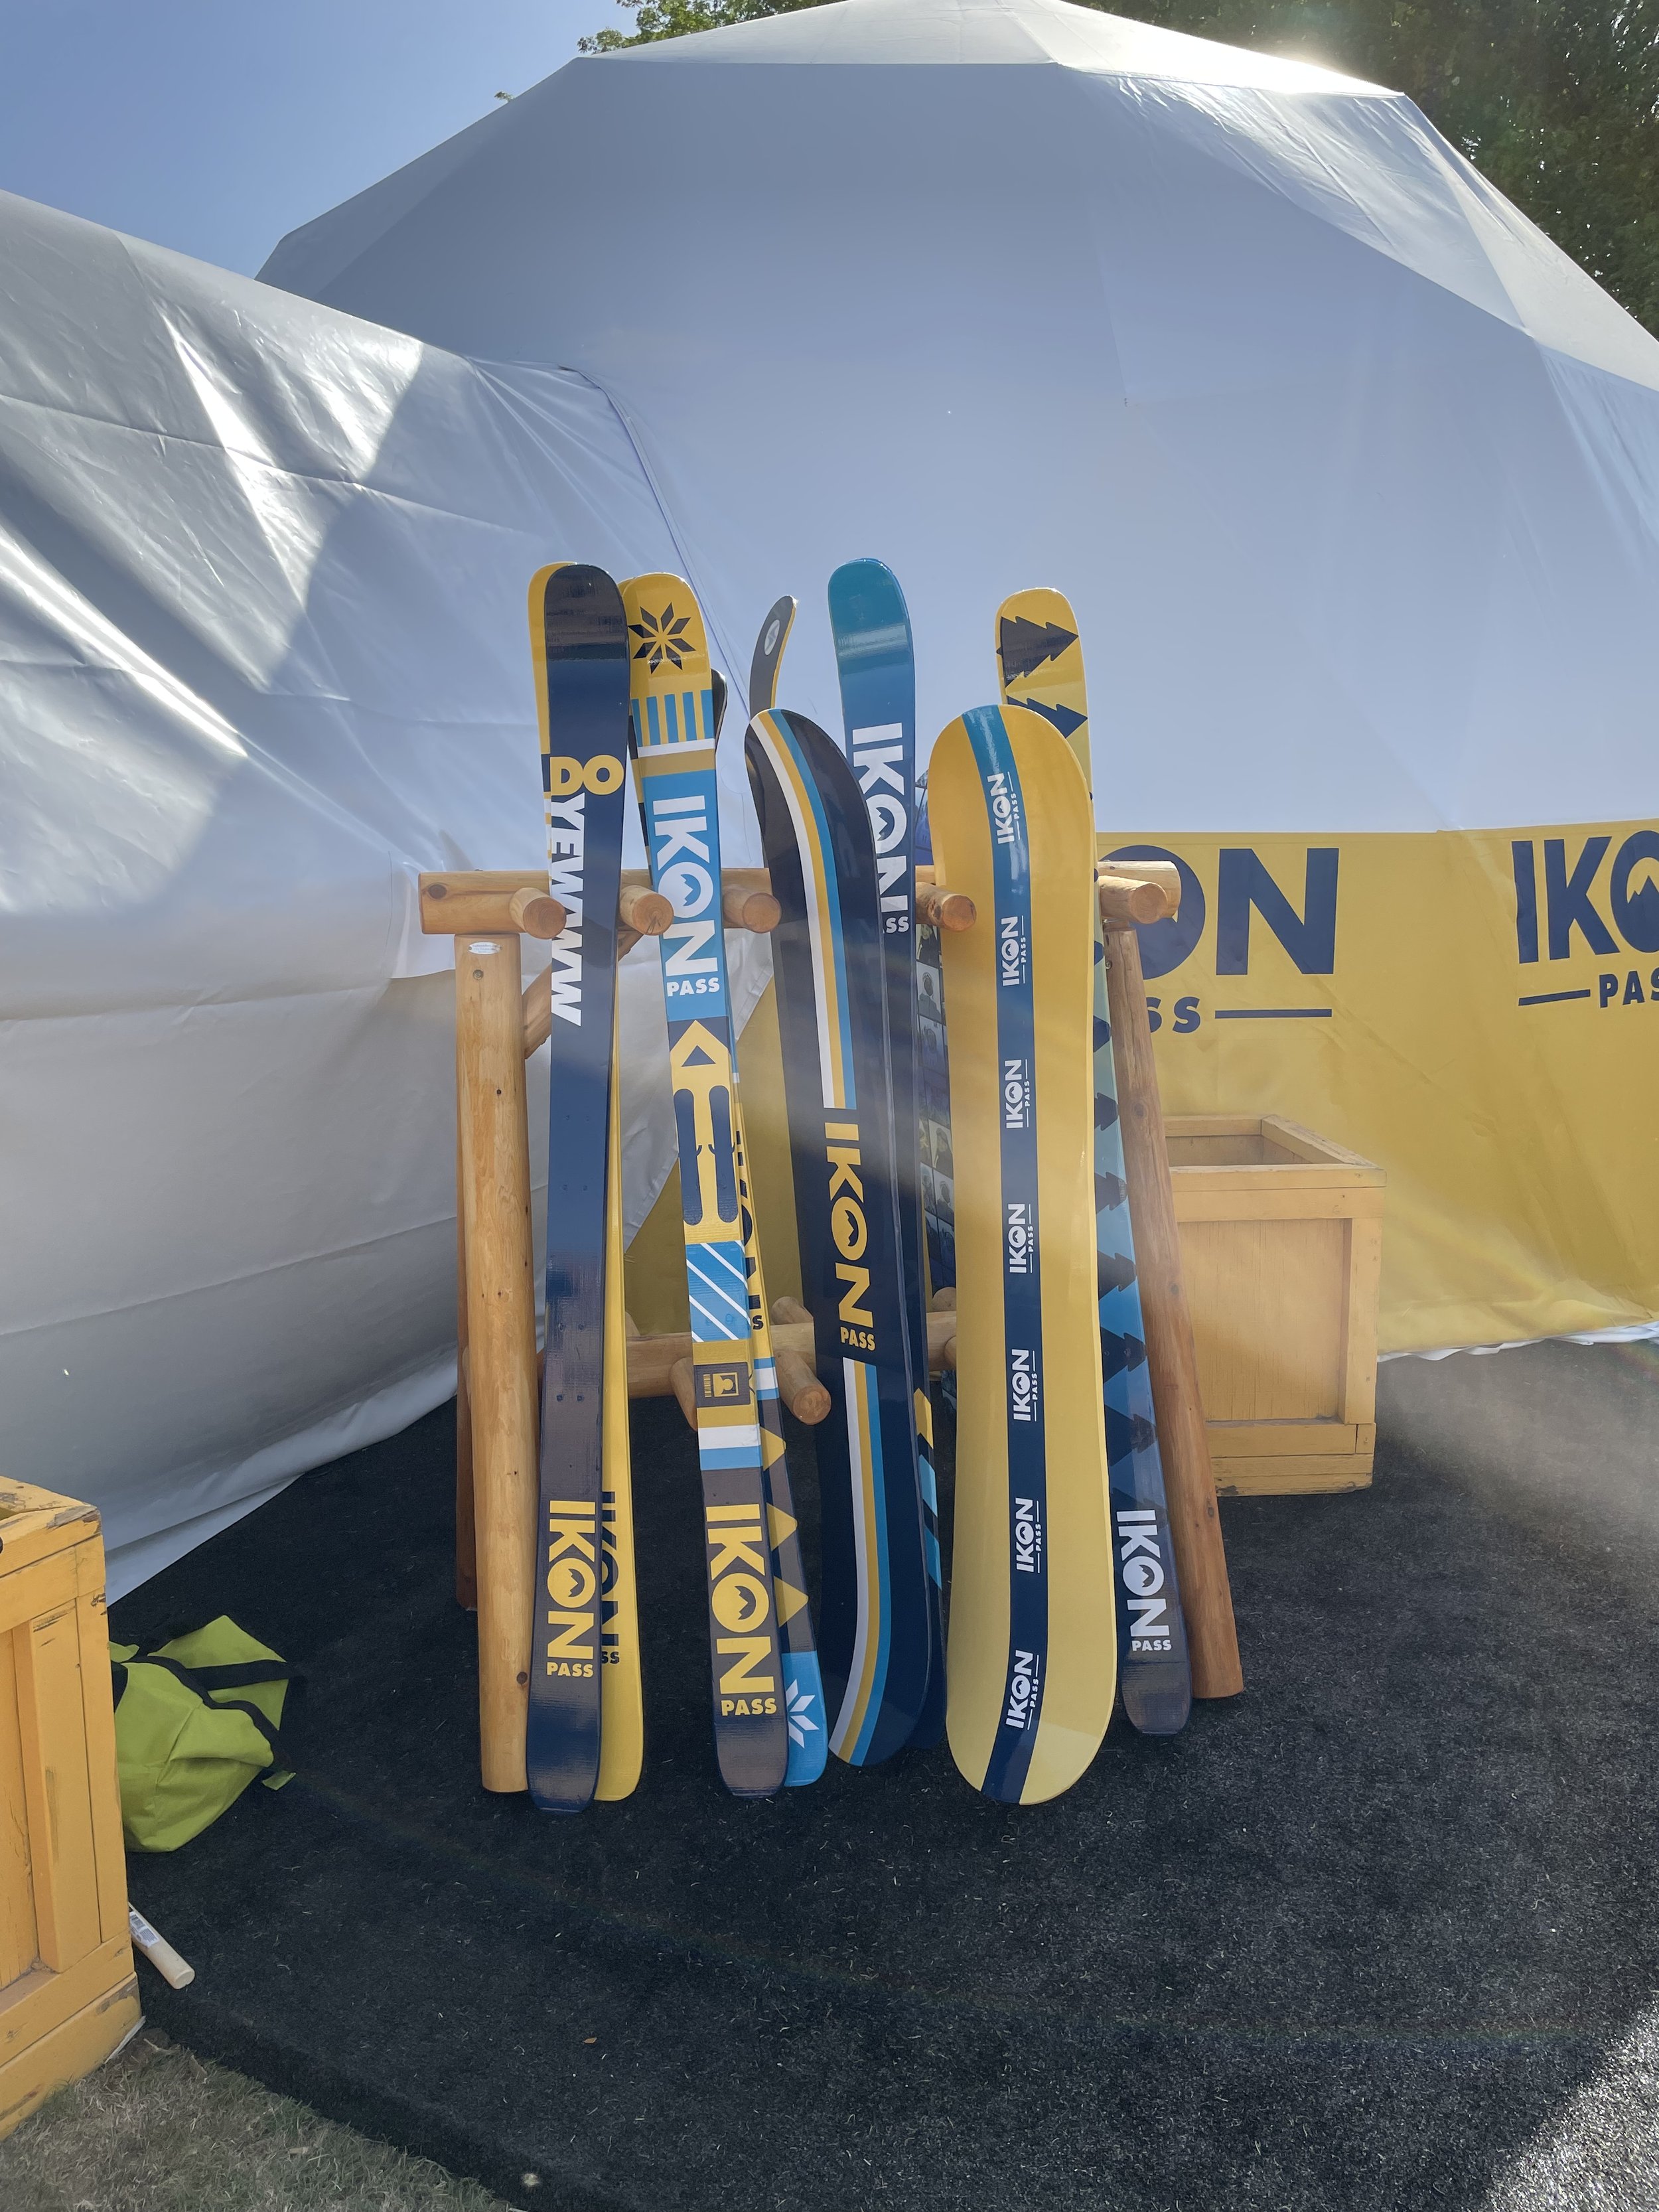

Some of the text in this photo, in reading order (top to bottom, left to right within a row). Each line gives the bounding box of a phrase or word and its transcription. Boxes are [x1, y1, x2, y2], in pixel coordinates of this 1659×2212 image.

[549, 755, 624, 796] DO
[987, 773, 1015, 844] IKON
[1011, 793, 1021, 820] PASS
[852, 723, 908, 913] IKON
[653, 796, 717, 976] IKON
[1512, 830, 1659, 964] IKO
[885, 917, 910, 934] SS
[1001, 916, 1020, 987] IKON
[667, 977, 720, 997] PASS
[1145, 996, 1202, 1034] SS
[1599, 967, 1659, 1008] PA
[1005, 1059, 1023, 1129] IKON
[824, 1122, 874, 1329] IKON
[1007, 1203, 1027, 1274] IKON
[839, 1325, 876, 1351] PASS
[1011, 1349, 1031, 1421] IKON
[1015, 1497, 1035, 1573] IKON
[547, 1500, 596, 1659] IKON
[705, 1503, 775, 1694] IKON
[1116, 1509, 1170, 1637] IKON
[546, 1661, 594, 1678] PASS
[1131, 1639, 1172, 1653] PASS
[721, 1698, 777, 1716] PASS
[1006, 1650, 1033, 1729] IKON
[1029, 1678, 1040, 1708] PASS
